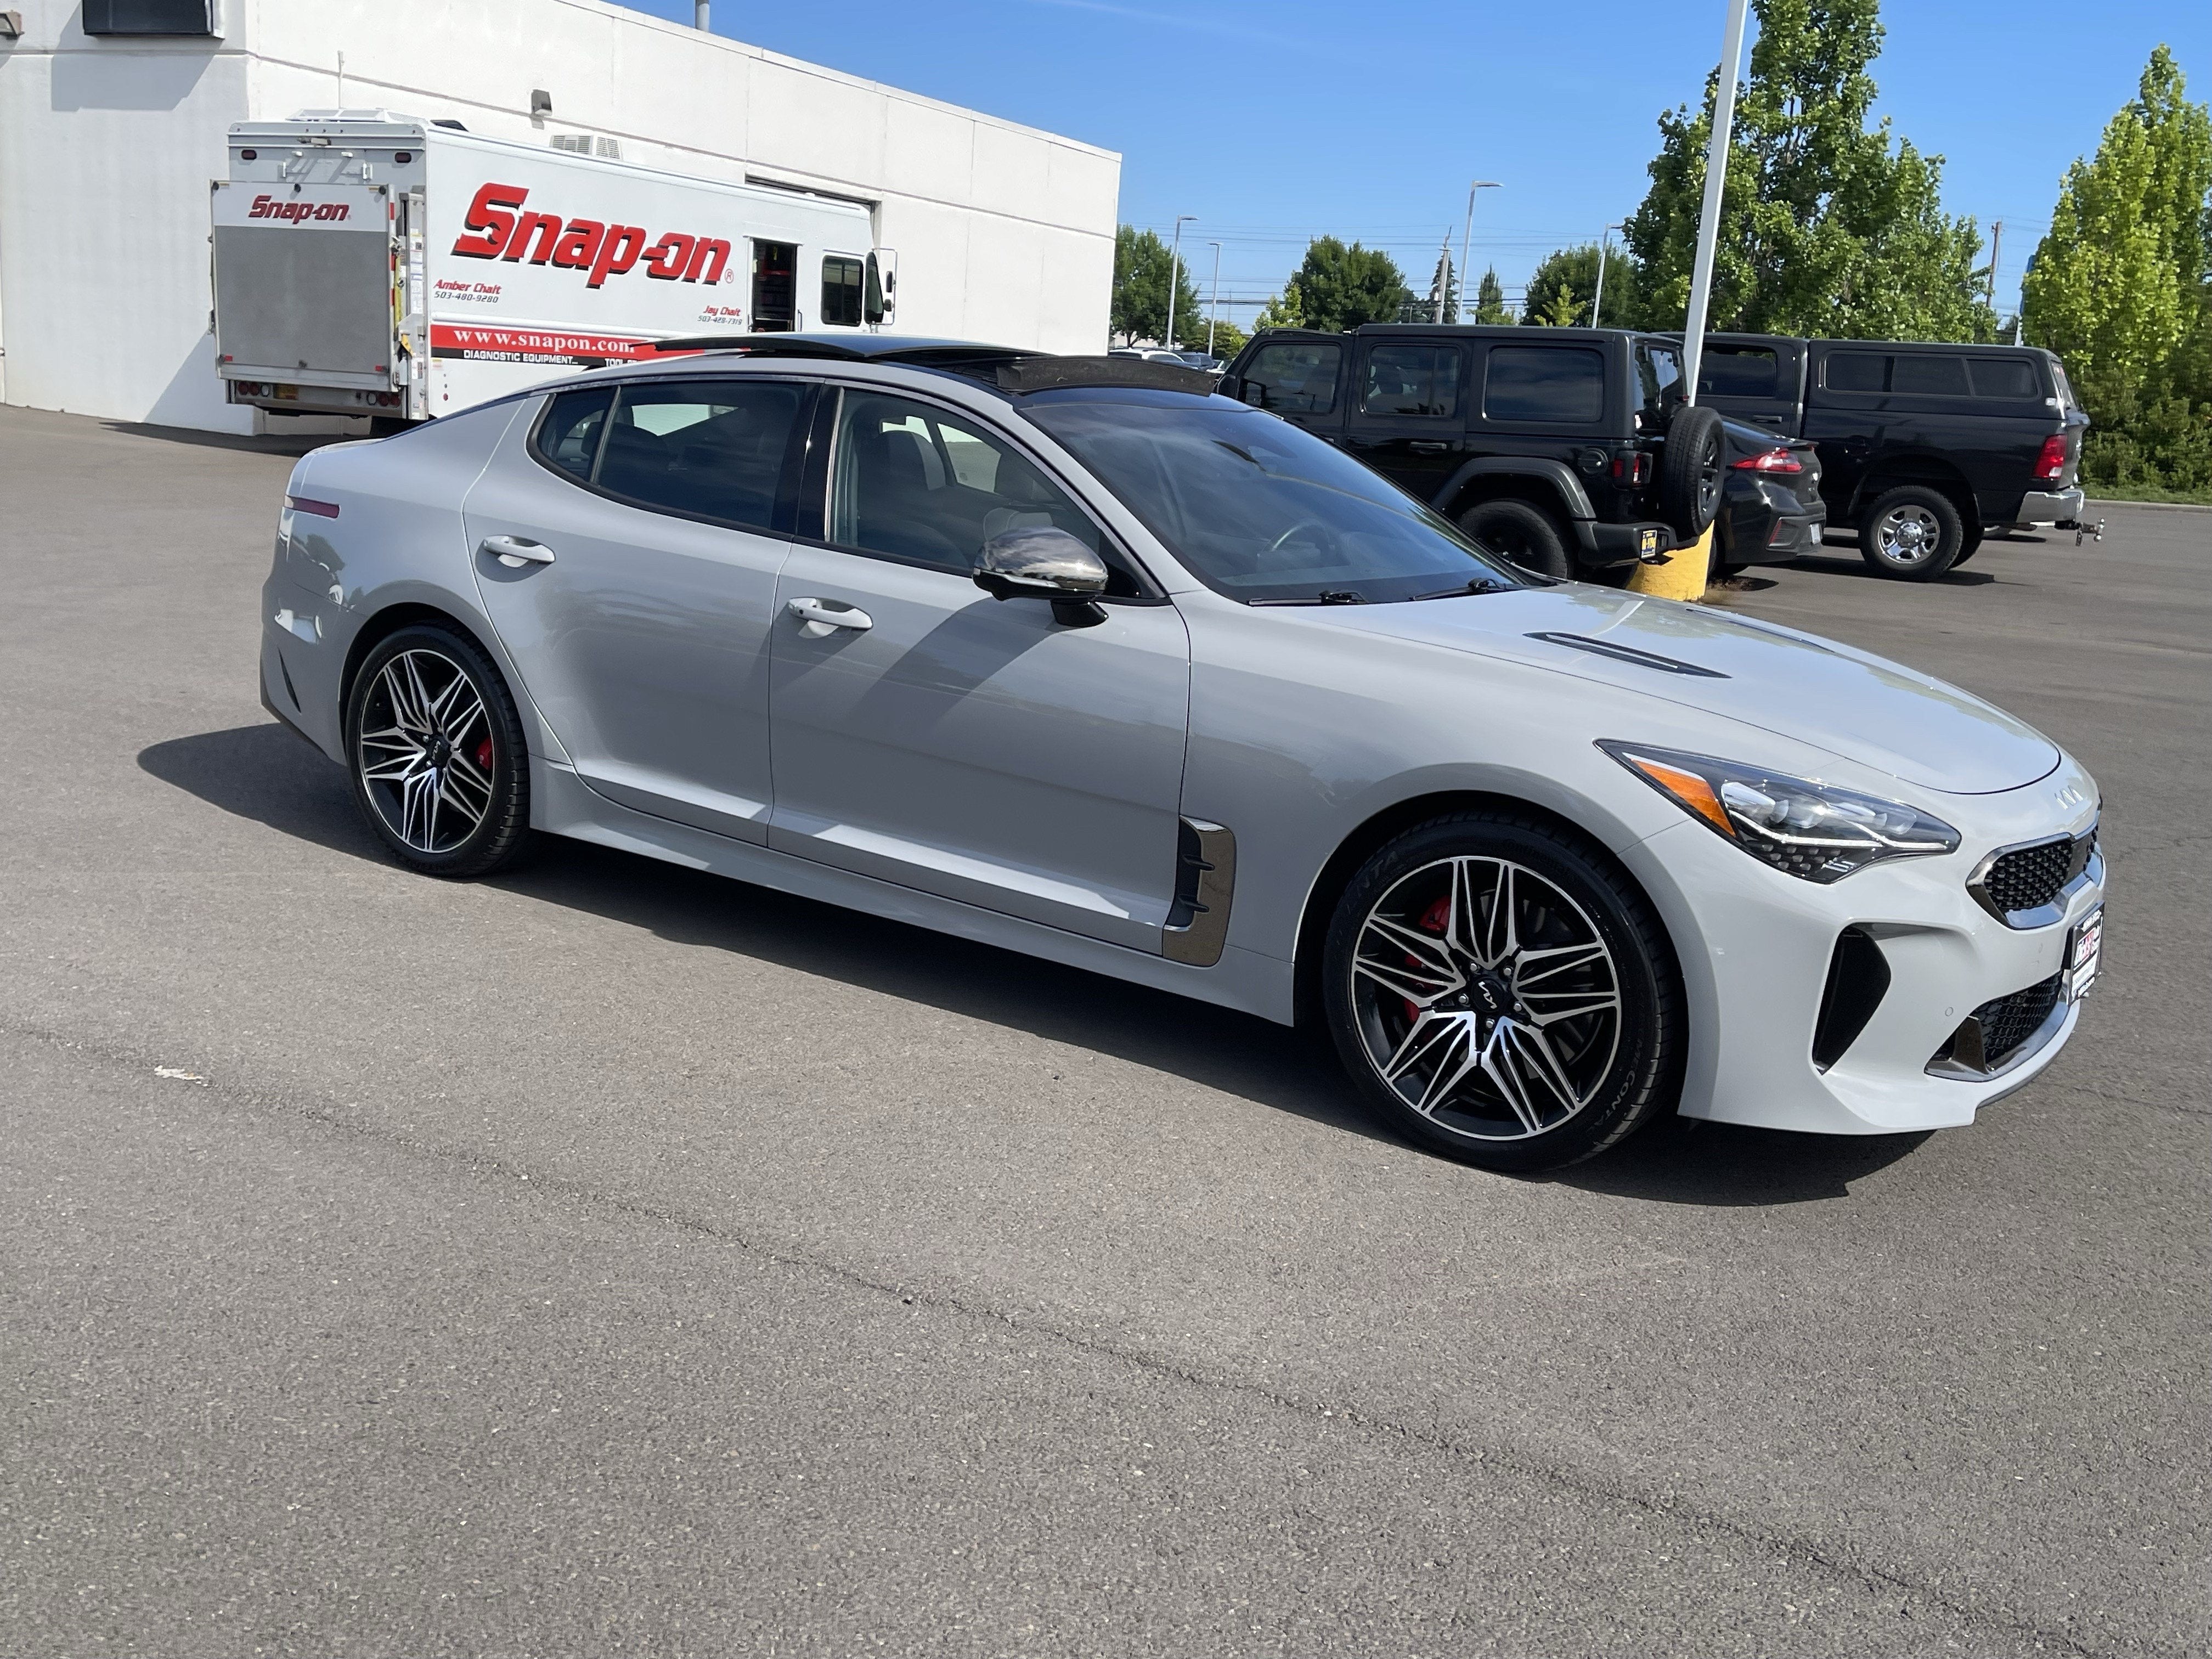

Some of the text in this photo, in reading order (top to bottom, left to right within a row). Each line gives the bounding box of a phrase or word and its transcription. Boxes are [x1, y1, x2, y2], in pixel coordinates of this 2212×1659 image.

[249, 195, 349, 224] Snap-on
[450, 182, 731, 288] Snap-on
[433, 279, 472, 291] Amber
[434, 291, 499, 303] 503-480-9280
[703, 305, 719, 316] Jay
[454, 330, 635, 353] www.snapon.com
[464, 349, 521, 362] DIAGNOSTIC
